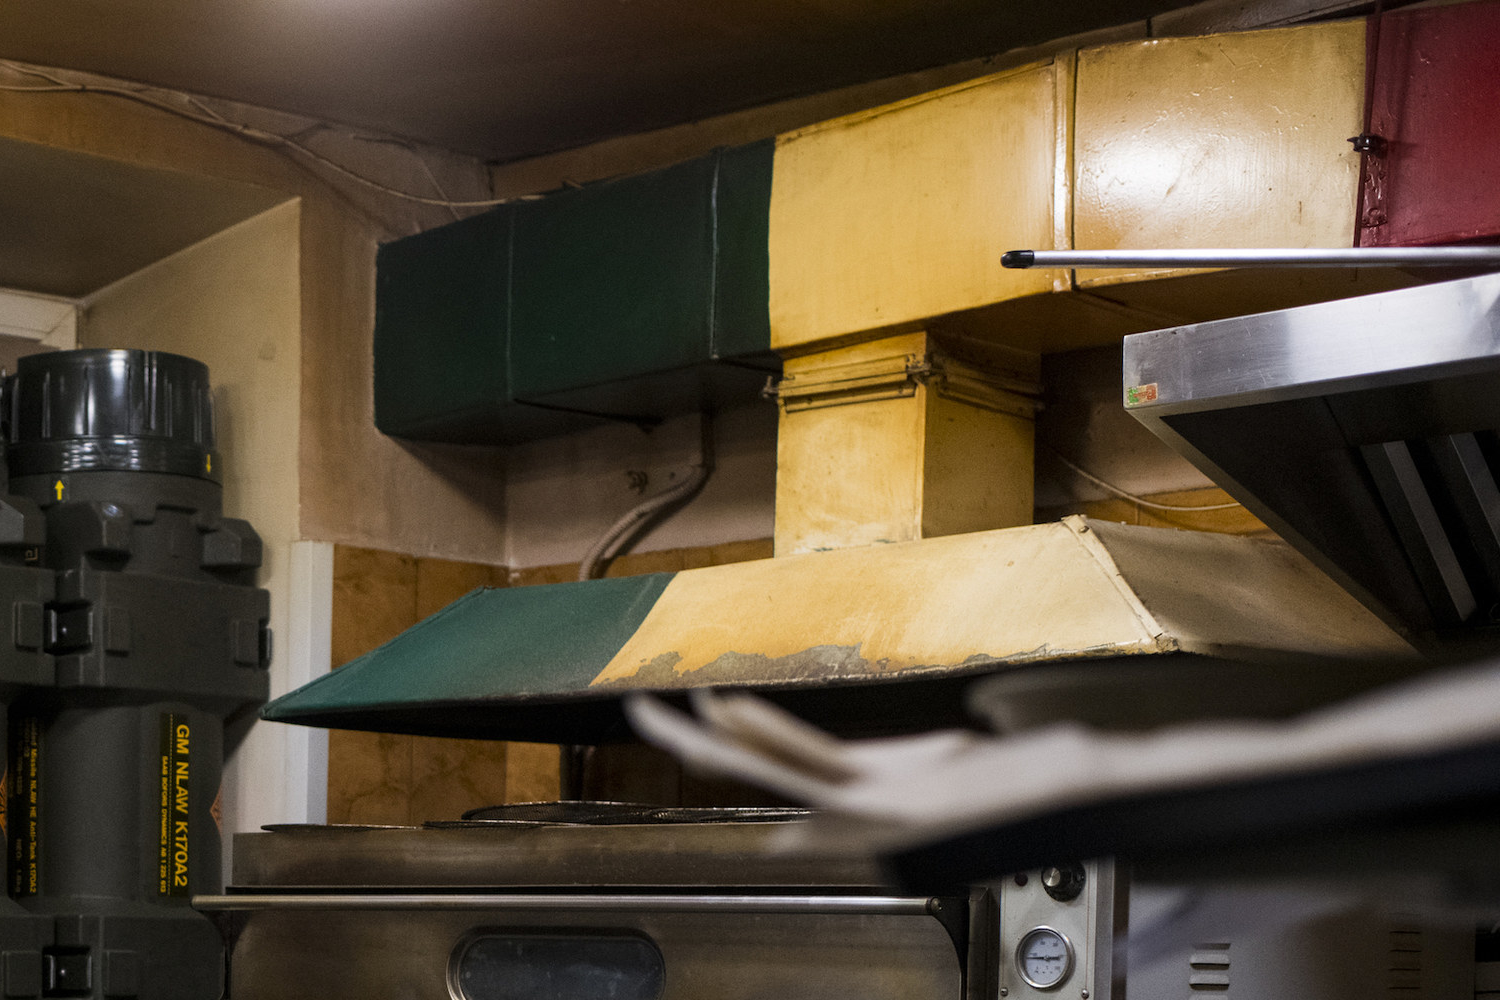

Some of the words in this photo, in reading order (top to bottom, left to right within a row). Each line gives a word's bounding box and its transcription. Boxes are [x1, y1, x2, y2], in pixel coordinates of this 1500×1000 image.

[176, 724, 190, 755] GM
[175, 761, 189, 814] NLAW
[174, 820, 188, 887] K170A2
